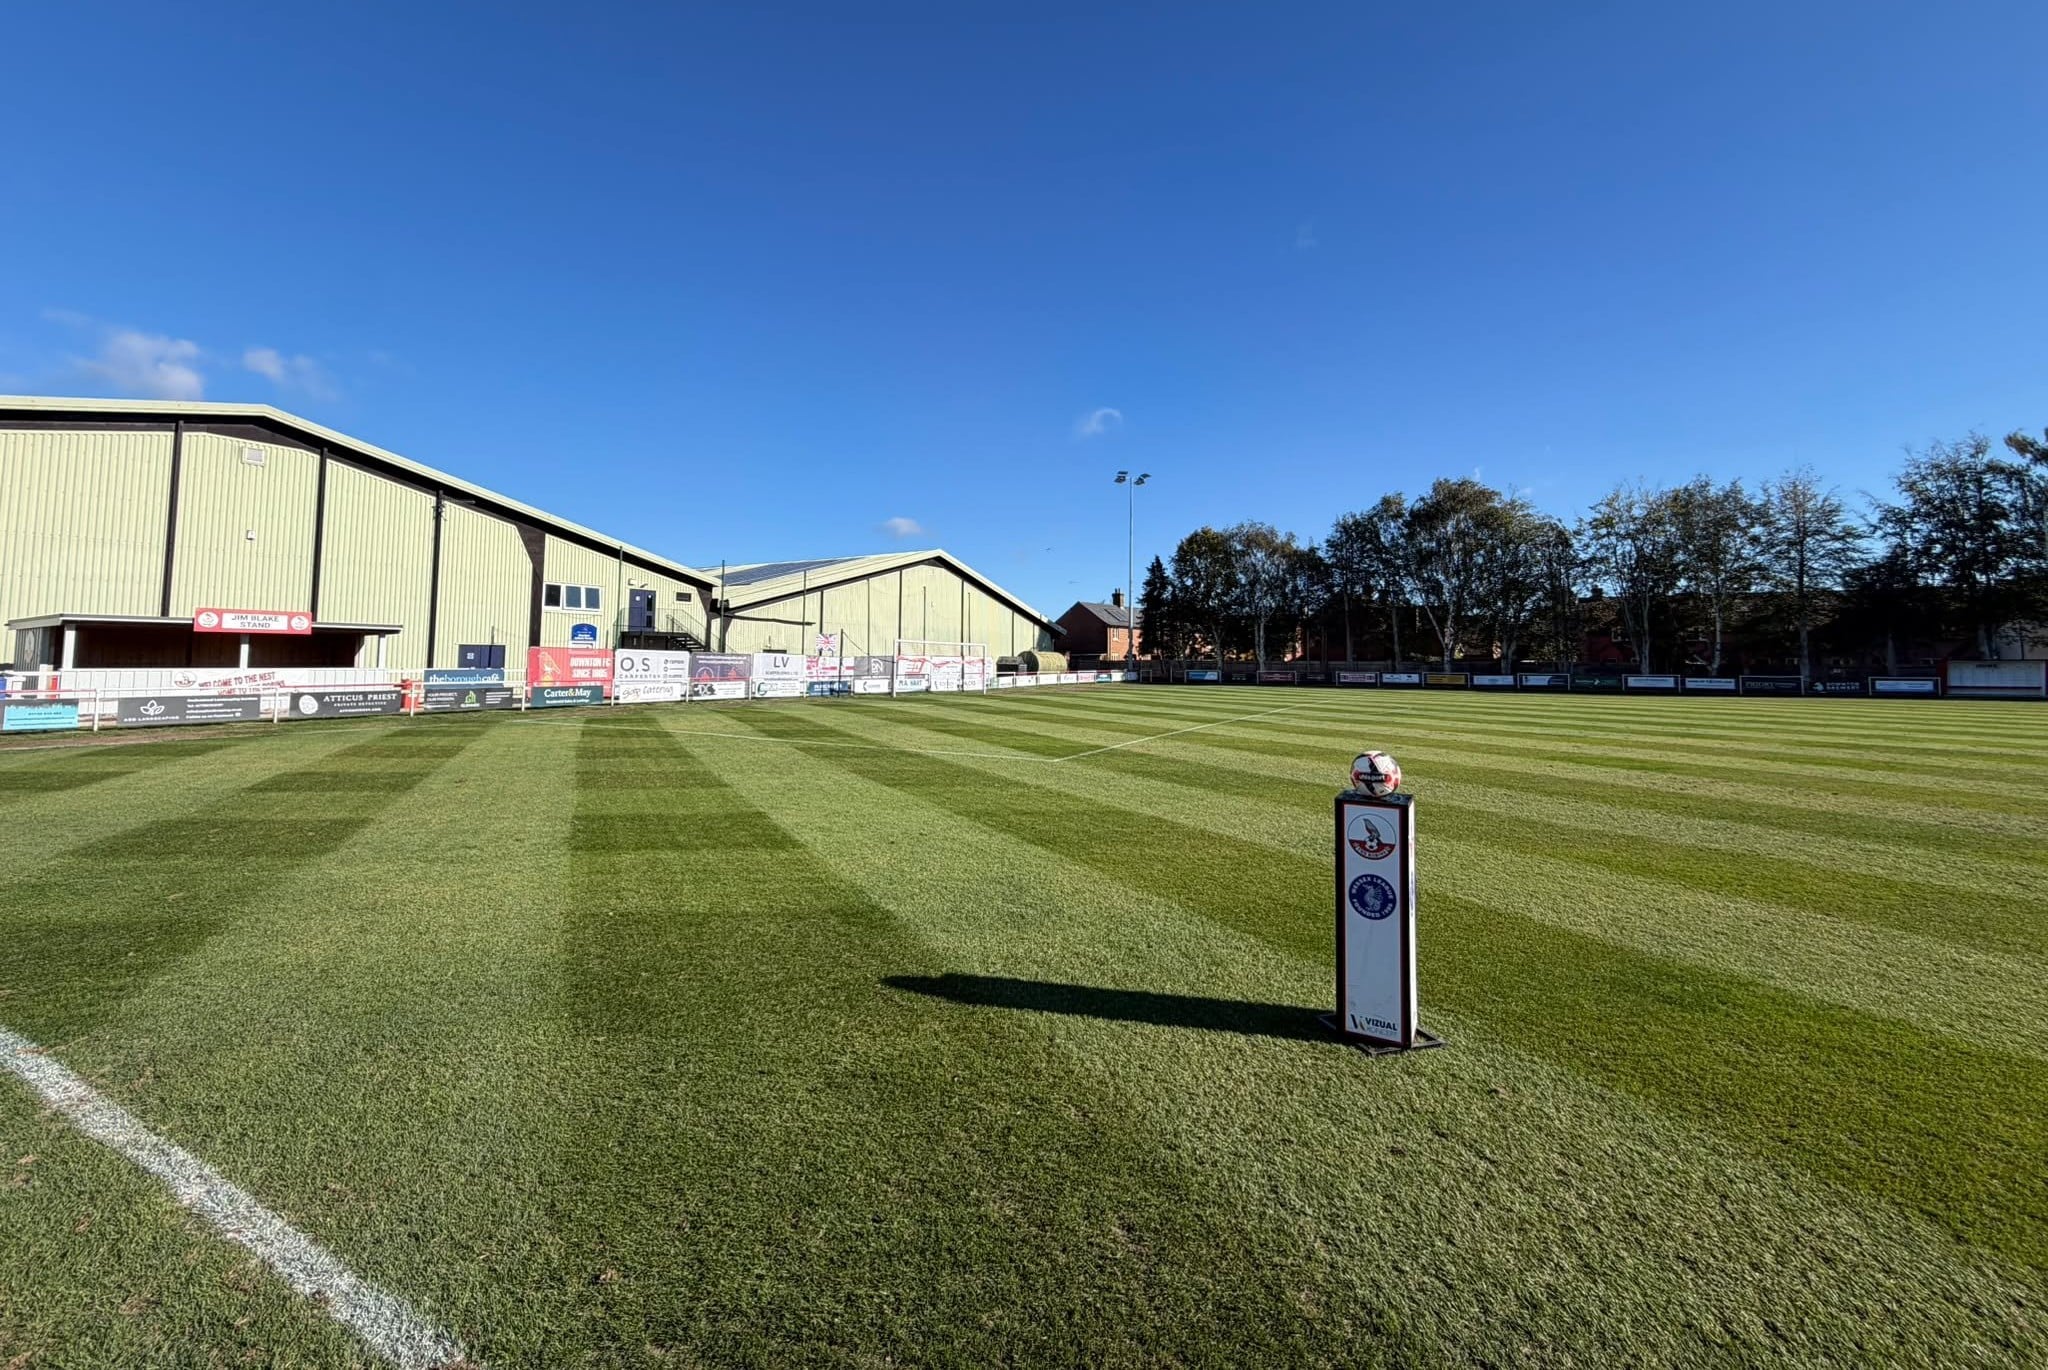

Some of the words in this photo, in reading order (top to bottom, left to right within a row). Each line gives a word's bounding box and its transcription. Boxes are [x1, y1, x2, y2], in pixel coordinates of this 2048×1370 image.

[250, 615, 280, 623] BLAKE
[240, 621, 271, 629] STAND
[570, 657, 600, 668] DOWNTON
[773, 656, 790, 668] LV
[233, 677, 244, 686] TO
[245, 674, 258, 683] THE
[258, 671, 276, 682] NEST
[322, 693, 364, 703] ATTICUS
[367, 692, 398, 701] PRIEST
[1365, 1017, 1398, 1031] VIZUAL
